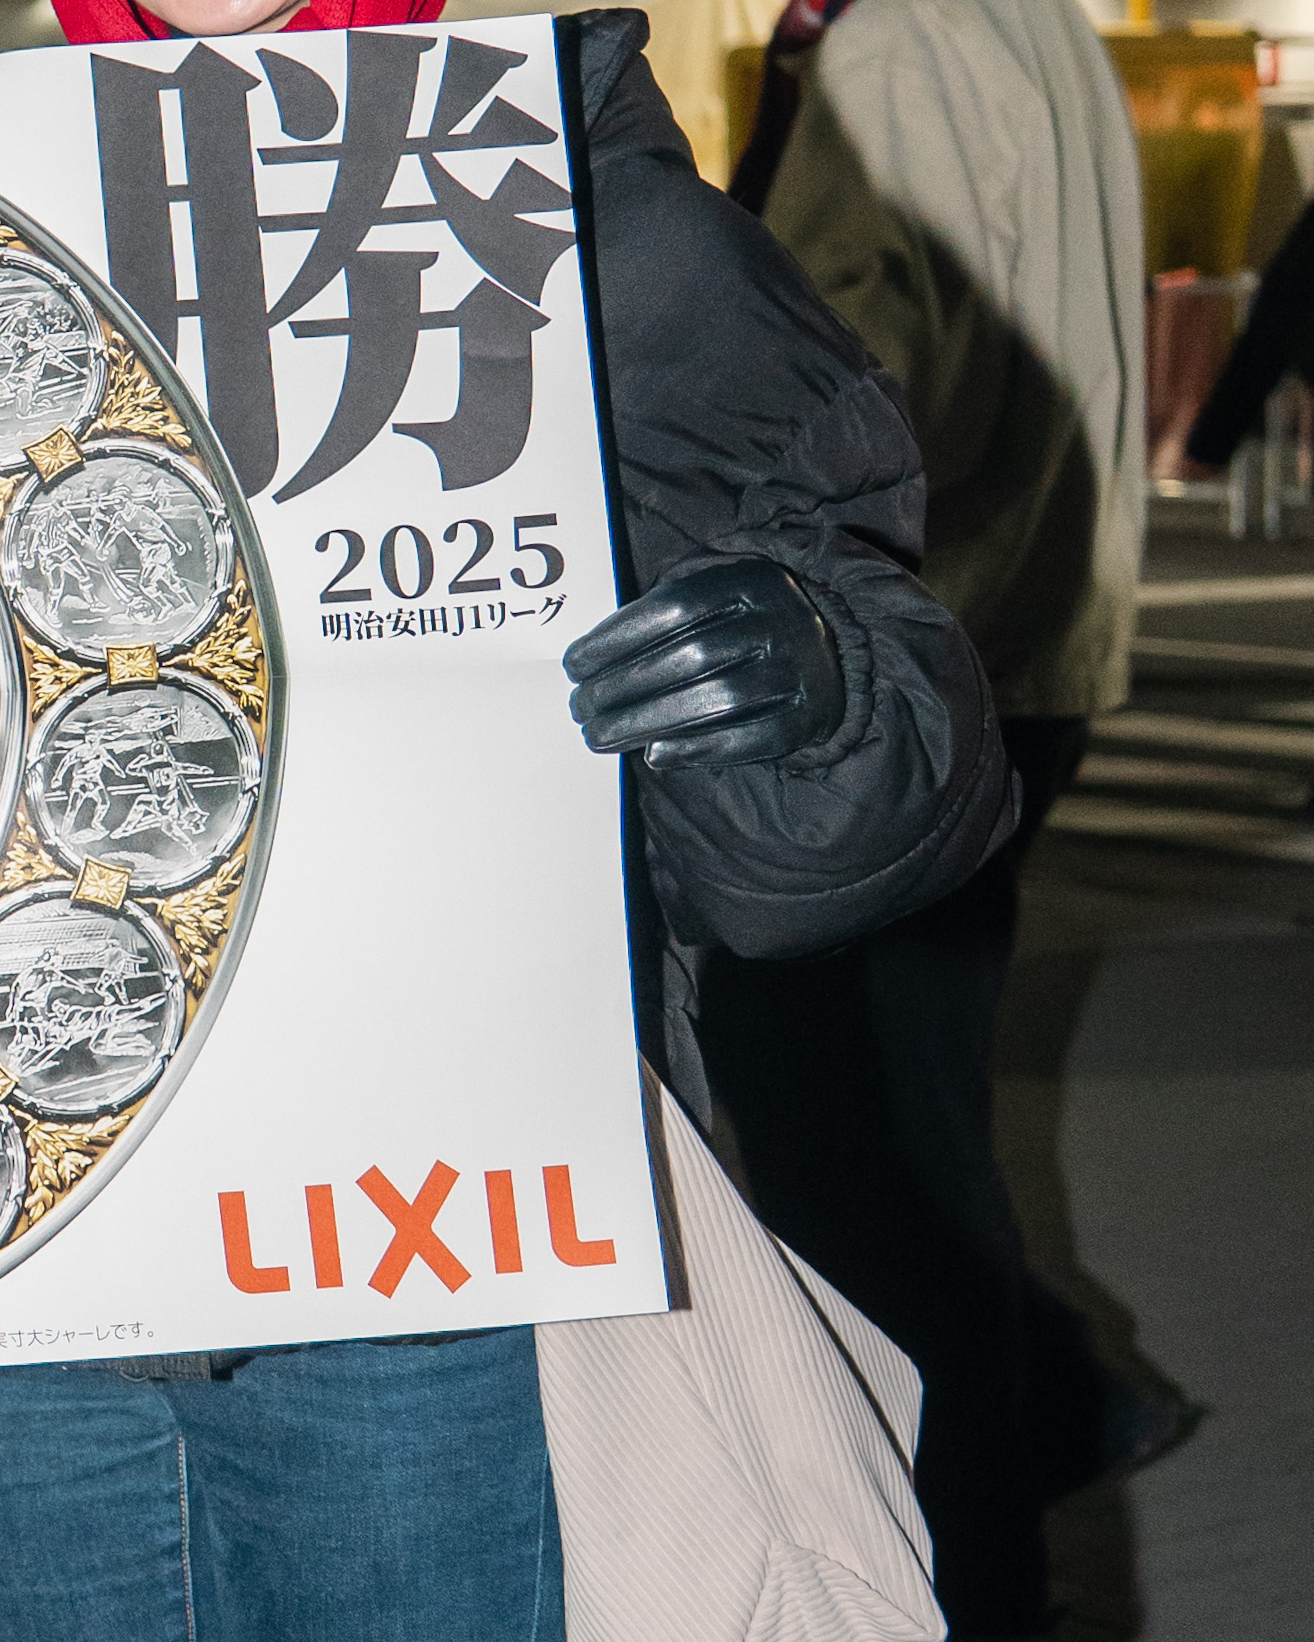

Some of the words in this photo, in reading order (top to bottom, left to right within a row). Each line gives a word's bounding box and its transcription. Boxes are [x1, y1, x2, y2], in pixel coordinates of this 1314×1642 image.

[89, 29, 579, 506] 勝
[314, 512, 565, 604] 2025
[321, 593, 567, 642] 明治安田J1リーグ
[218, 1159, 617, 1299] LIXIL
